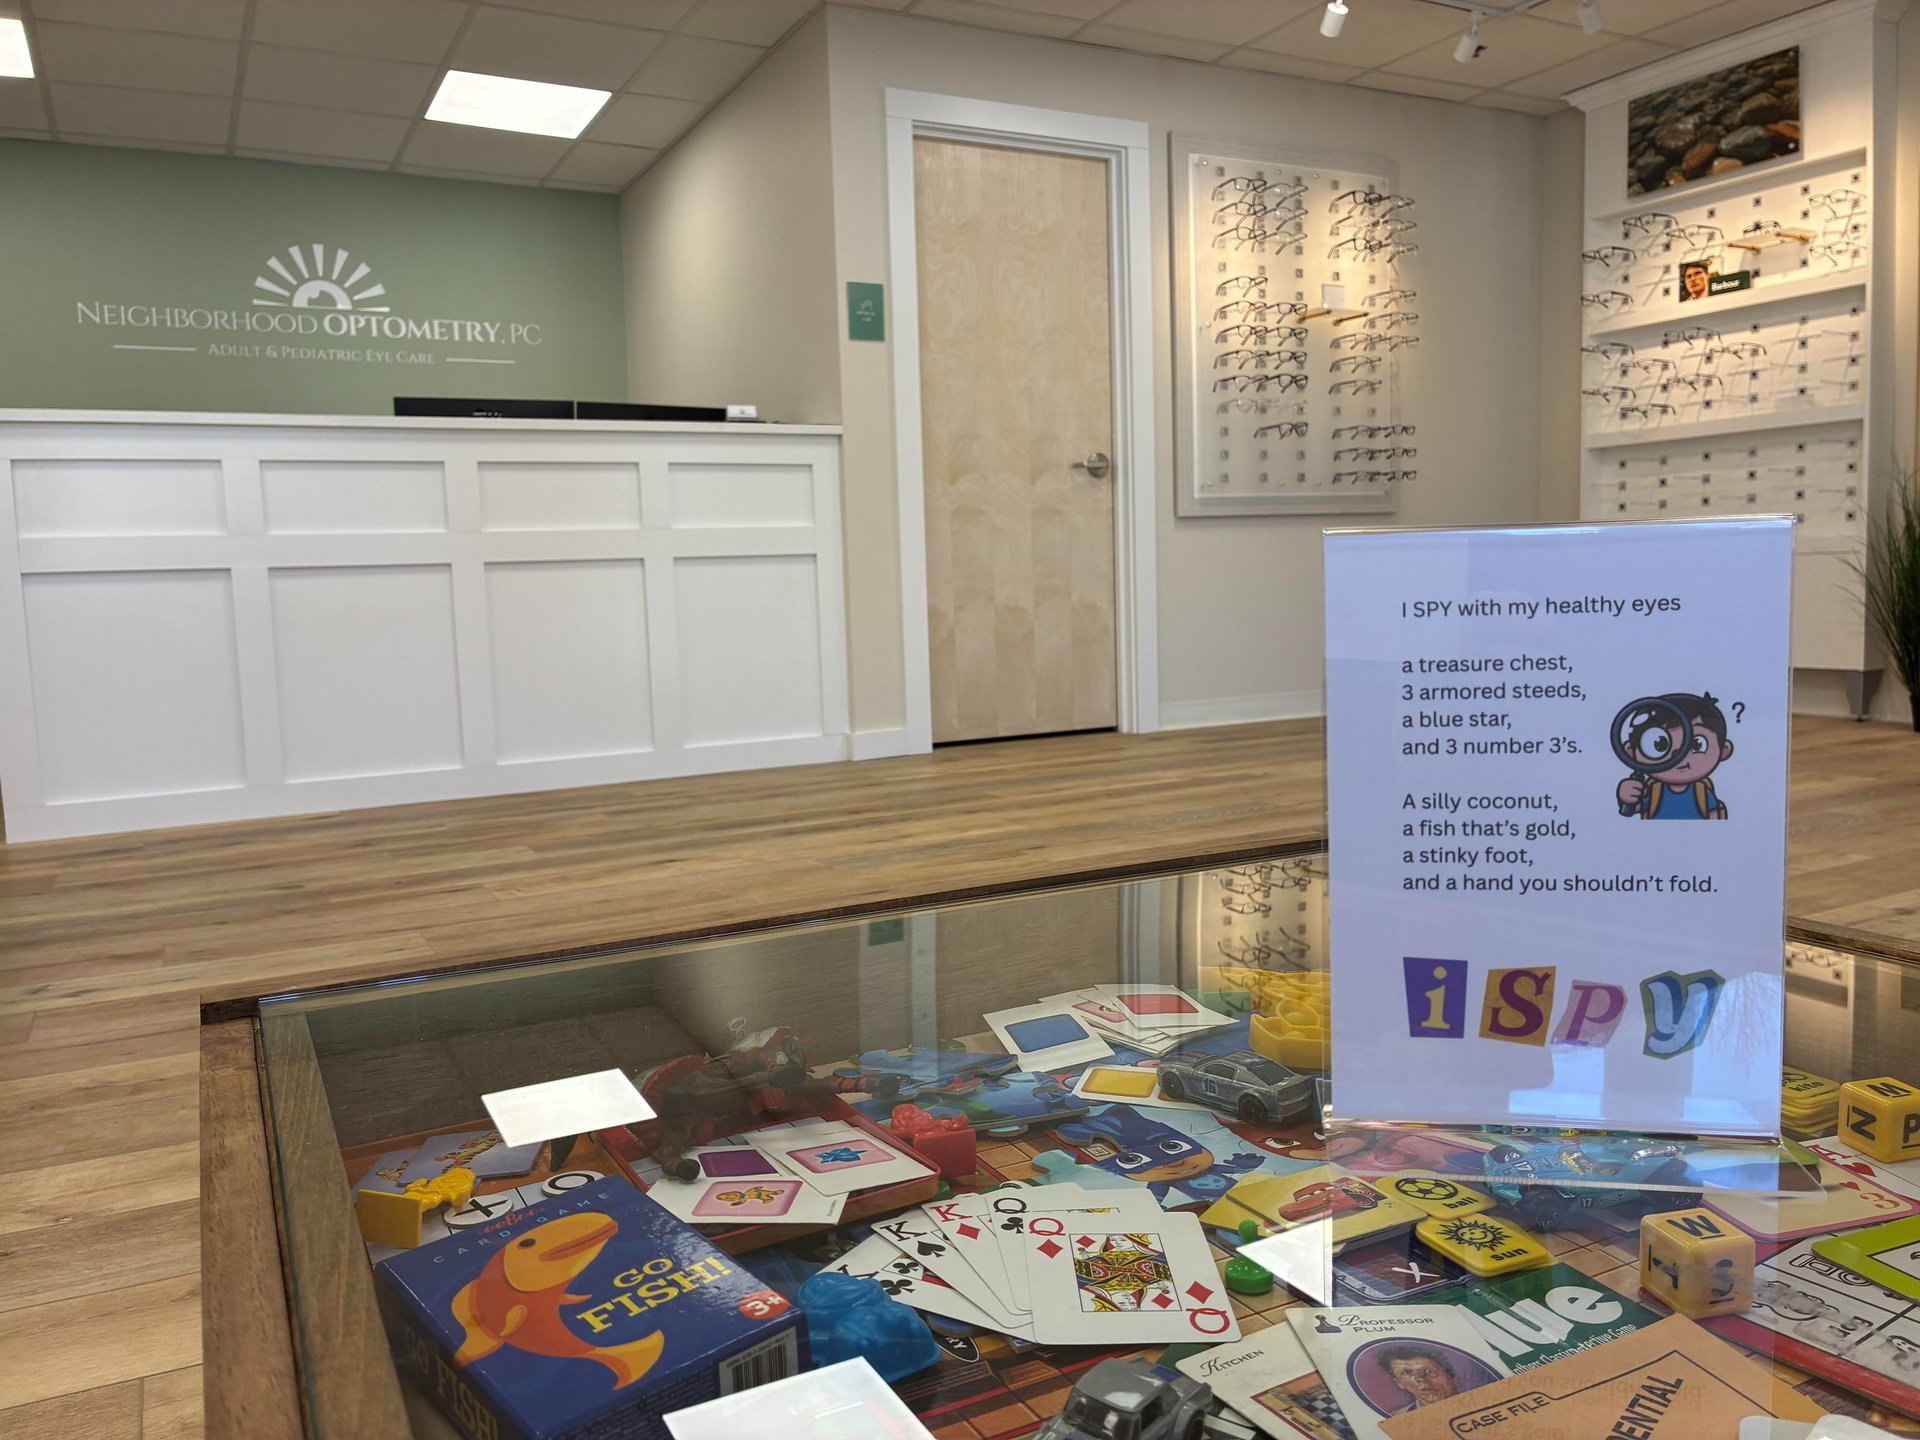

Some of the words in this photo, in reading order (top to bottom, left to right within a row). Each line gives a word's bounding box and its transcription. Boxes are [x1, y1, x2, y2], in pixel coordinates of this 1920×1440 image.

[76, 301, 318, 335] NEIGHBORHOOD
[510, 323, 542, 345] PC
[208, 343, 260, 358] ADULT
[266, 345, 278, 358] &
[282, 345, 362, 362] PEDIATRIC
[366, 350, 393, 363] EYE
[397, 351, 435, 365] CARE
[1402, 601, 1407, 619] I
[1413, 600, 1453, 618] SPY
[1457, 598, 1502, 617] with
[1508, 601, 1540, 620] my
[1545, 595, 1626, 618] healthy
[1631, 597, 1682, 617] eyes
[1401, 660, 1414, 674] a
[1418, 657, 1505, 674] treasure
[1509, 653, 1573, 675] chest,
[1401, 683, 1414, 701] 3
[1419, 681, 1506, 701] armored
[1512, 680, 1587, 702] steeds,
[1401, 714, 1415, 729] a
[1419, 710, 1464, 729] blue
[1468, 711, 1512, 731] star,
[1402, 737, 1440, 756] and
[1445, 738, 1458, 755] 3
[1463, 736, 1545, 755] number
[1548, 736, 1583, 755] 3's.
[1402, 793, 1417, 810] A
[1421, 792, 1462, 814] silly
[1466, 793, 1558, 813] coconut,
[1402, 823, 1415, 837] a
[1418, 819, 1456, 837] fish
[1460, 819, 1520, 837] that's
[1524, 819, 1576, 841] gold,
[1402, 850, 1415, 864] a
[1419, 846, 1480, 868] stinky
[1484, 846, 1534, 868] foot,
[1402, 873, 1440, 891] and
[1445, 877, 1458, 891] a
[1463, 873, 1514, 892] hand
[1518, 878, 1557, 896] you
[1563, 874, 1664, 893] shouldn't
[1668, 874, 1718, 893] fold.
[929, 1203, 973, 1223] K
[992, 1197, 1030, 1214] Q
[1442, 1196, 1479, 1209] ball
[433, 1230, 511, 1264] CARD
[536, 1192, 609, 1223] GAME
[879, 1220, 928, 1242] K
[1028, 1217, 1066, 1236] Q
[1490, 1248, 1529, 1261] sun
[613, 1258, 673, 1288] GO
[576, 1256, 732, 1334] FISH!
[746, 1294, 782, 1316] 3+
[1185, 1308, 1231, 1335] Q
[1338, 1314, 1436, 1328] PROFESSOR
[1353, 1325, 1396, 1334] PLUM
[1456, 1286, 1623, 1358] lue
[1200, 1350, 1265, 1377] KITCHEN
[1457, 1411, 1508, 1434] CASE
[1507, 1396, 1550, 1417] FILE
